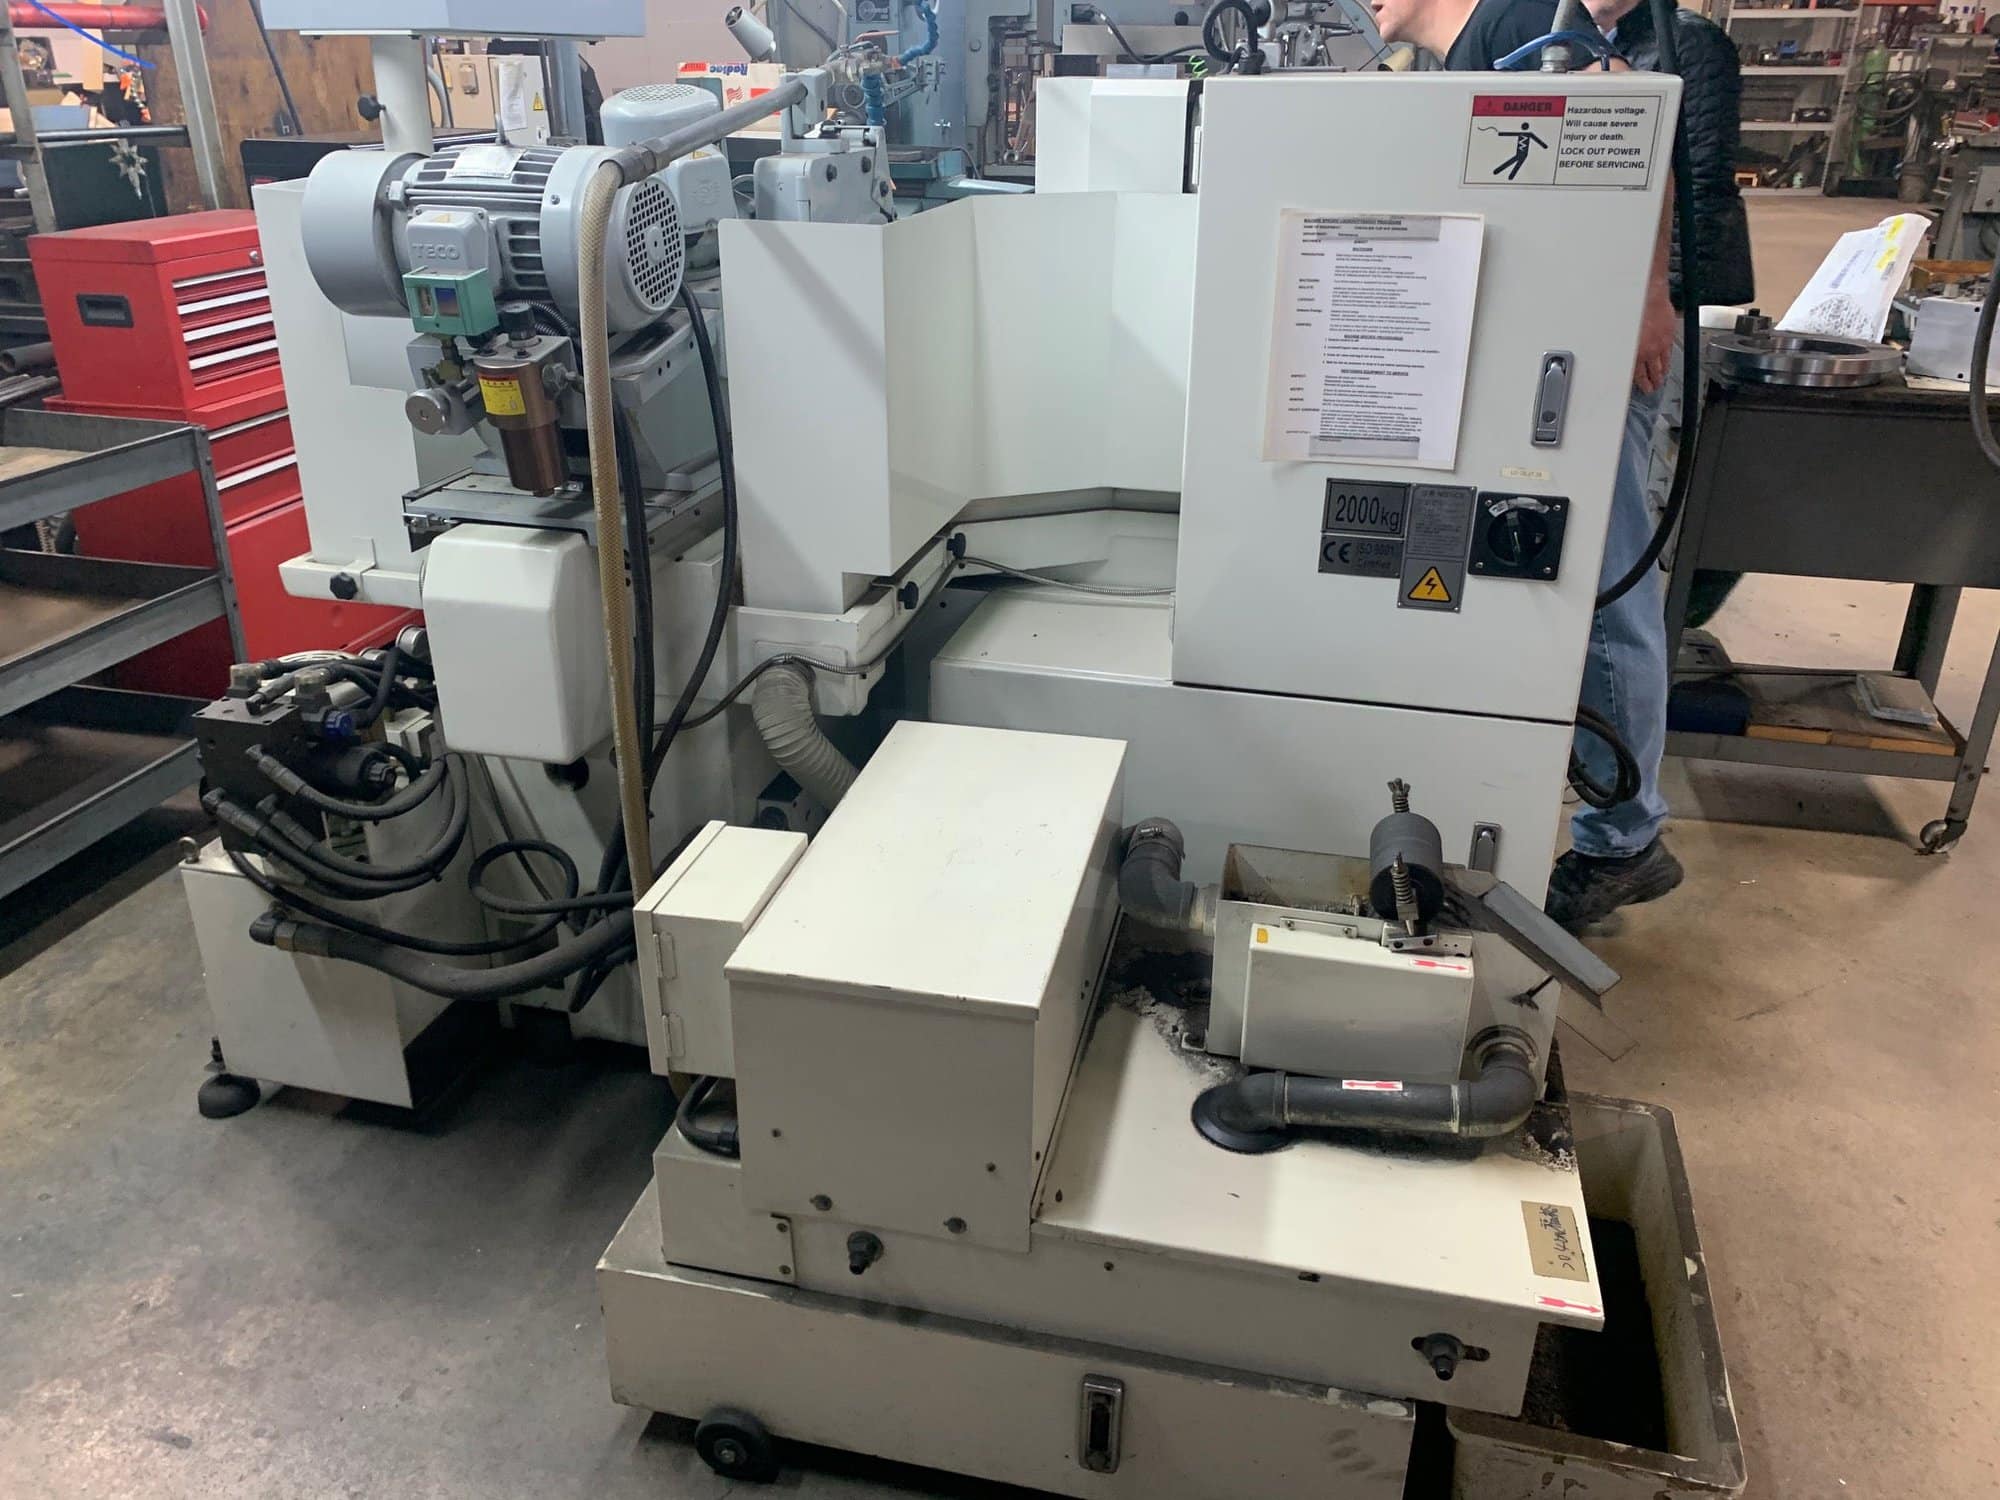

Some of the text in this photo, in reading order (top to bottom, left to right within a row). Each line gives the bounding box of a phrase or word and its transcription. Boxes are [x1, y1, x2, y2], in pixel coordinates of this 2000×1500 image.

[710, 63, 748, 76] Radiac
[1503, 101, 1553, 112] DANGER
[1567, 106, 1647, 116] Hazardous voltage.
[1565, 119, 1581, 127] Will
[1563, 133, 1586, 142] injury
[1599, 133, 1624, 141] death.
[1560, 147, 1641, 156] LOCK OUT POWER
[1559, 160, 1647, 169] BEFORE SERVICING.
[412, 243, 460, 260] TECO
